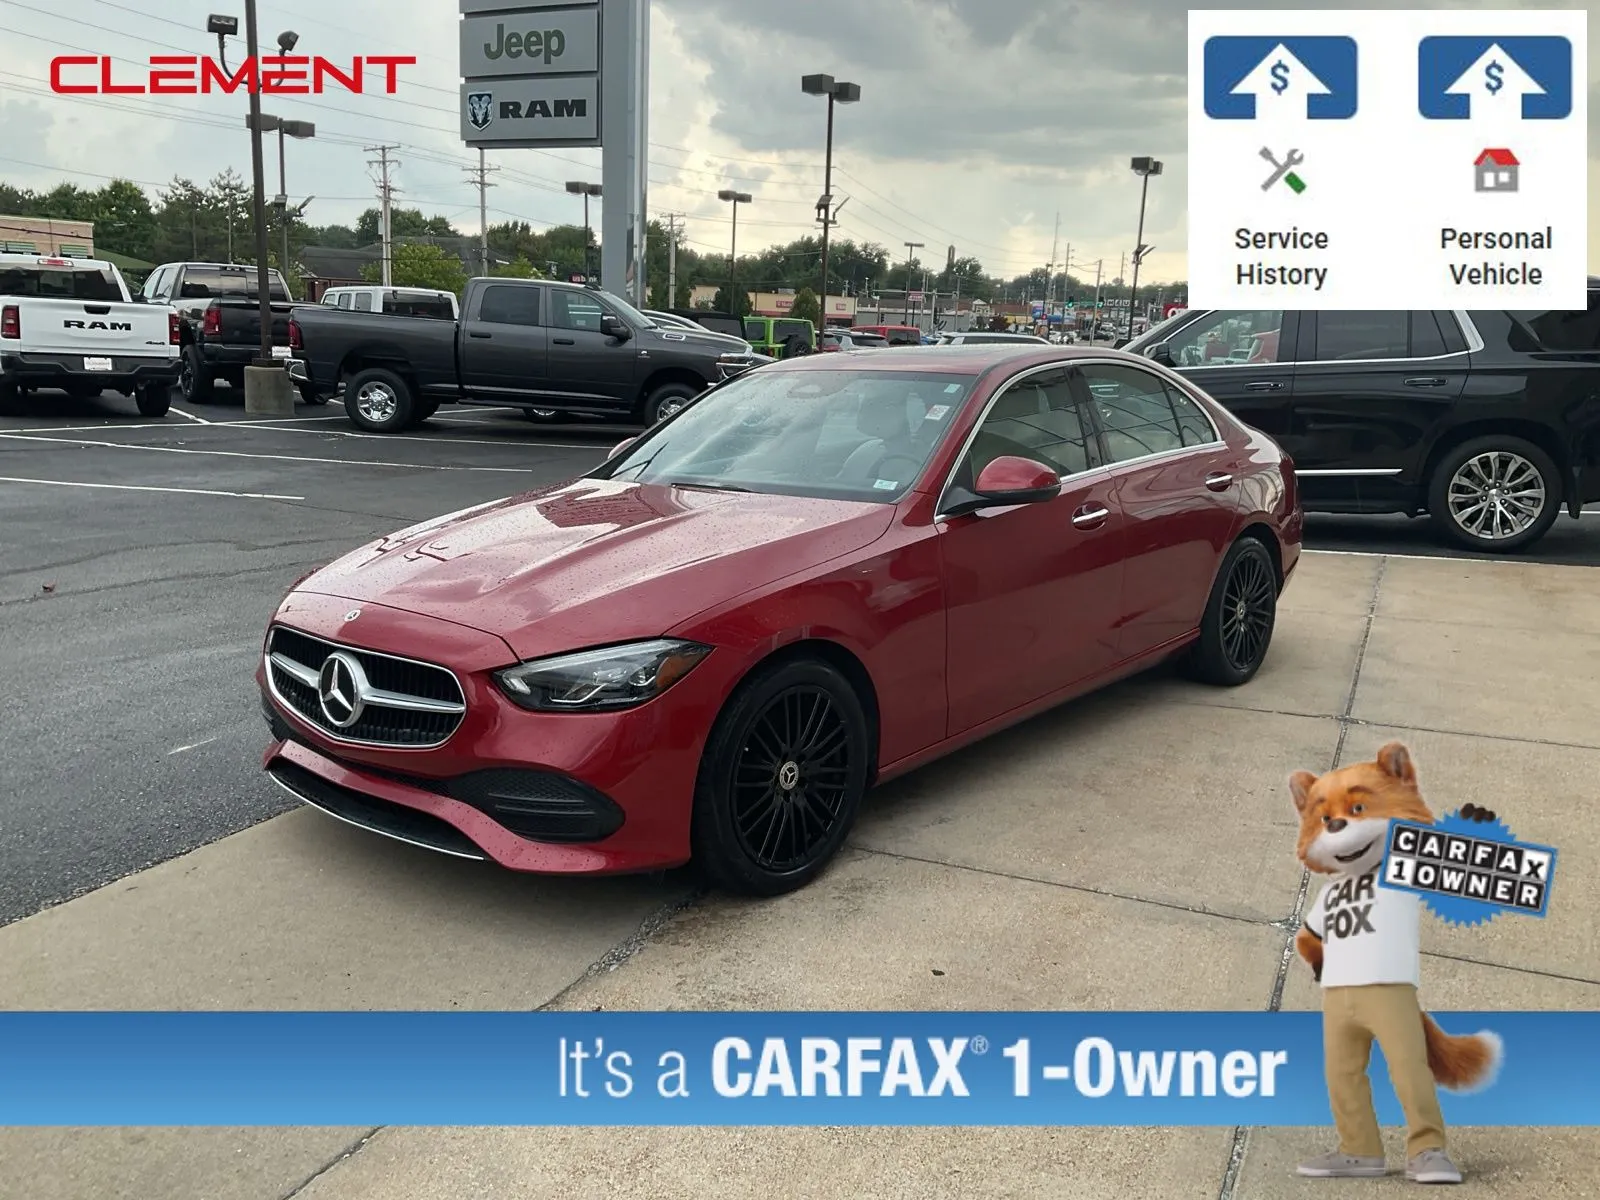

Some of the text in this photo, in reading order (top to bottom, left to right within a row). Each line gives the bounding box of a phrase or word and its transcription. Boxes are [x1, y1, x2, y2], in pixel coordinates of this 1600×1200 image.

[484, 24, 565, 64] Jeep
[499, 99, 587, 119] RAM
[64, 320, 131, 331] RAM
